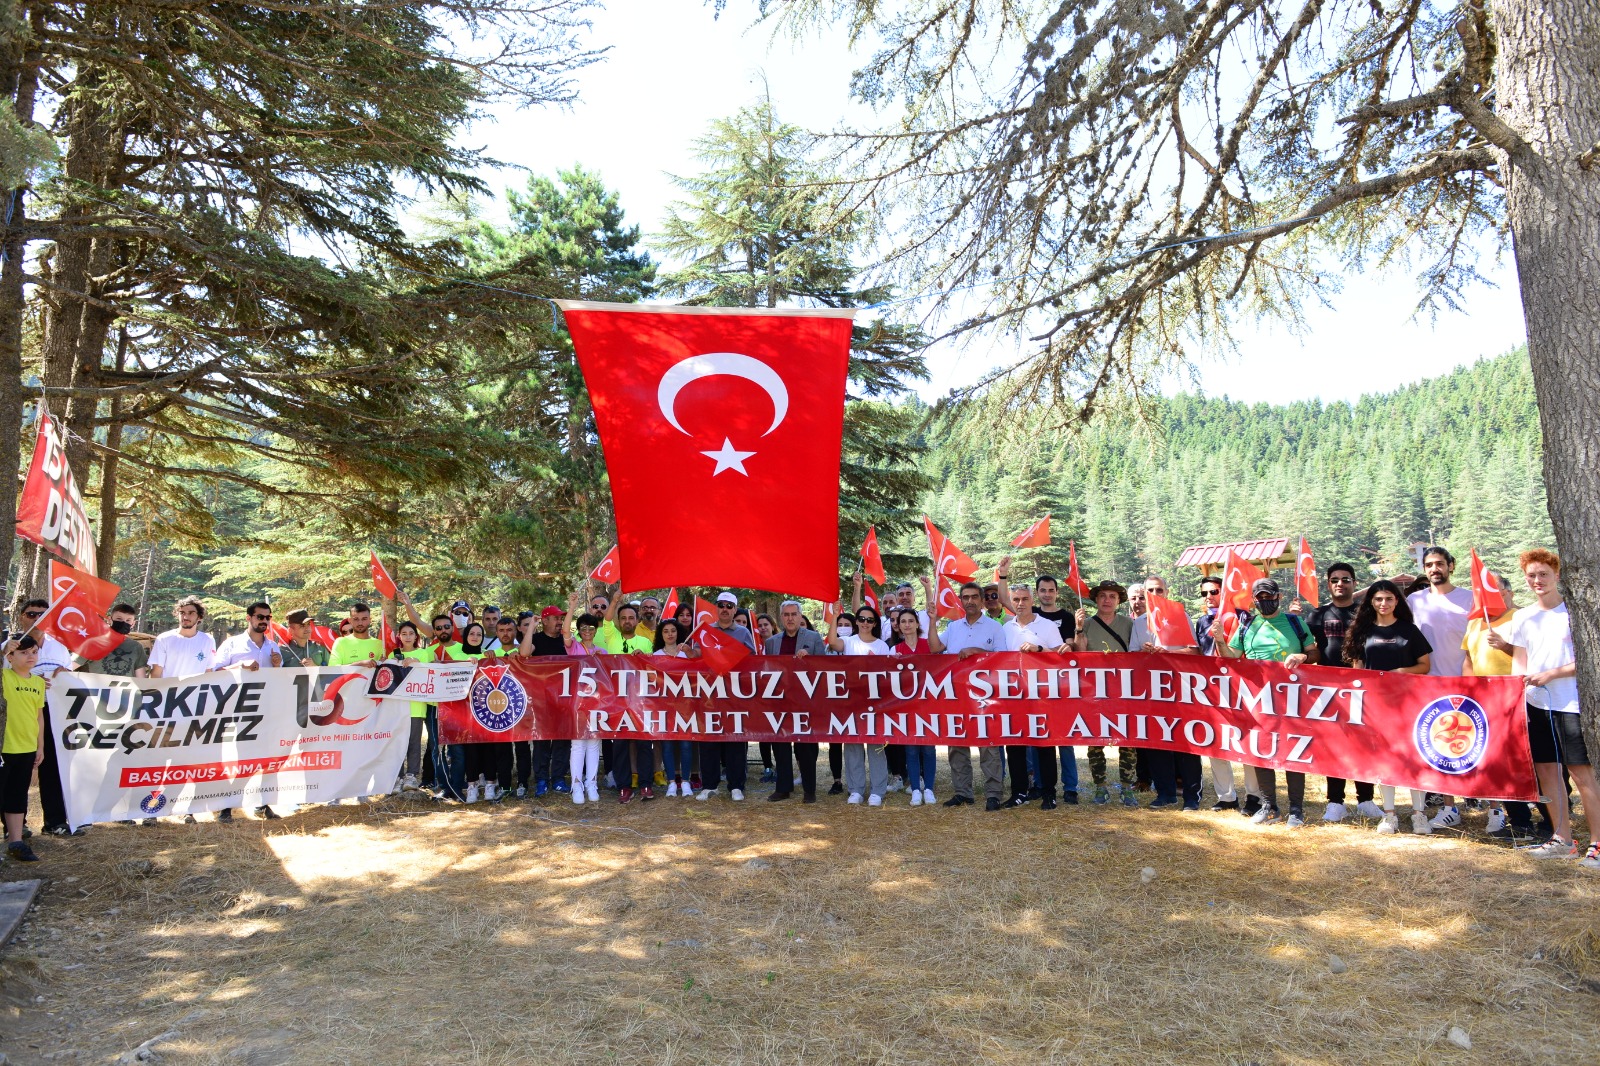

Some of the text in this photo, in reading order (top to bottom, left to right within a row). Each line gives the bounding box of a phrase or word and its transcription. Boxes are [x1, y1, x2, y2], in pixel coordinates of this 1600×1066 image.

[42, 423, 62, 480] 15
[65, 680, 266, 721] TÜRKİYE
[558, 659, 1367, 726] 15 TEMMUZ VE TÜM ŞEHİTLERİMİZİ
[62, 714, 264, 755] GEÇİLMEZ
[352, 733, 372, 741] Birlik
[373, 731, 392, 740] Günü
[588, 706, 1314, 764] RAHMET VE MİNNETLE ANIYORUZ
[128, 752, 335, 784] BAŞKONUŞ ANMA ETKİNLİĞİ
